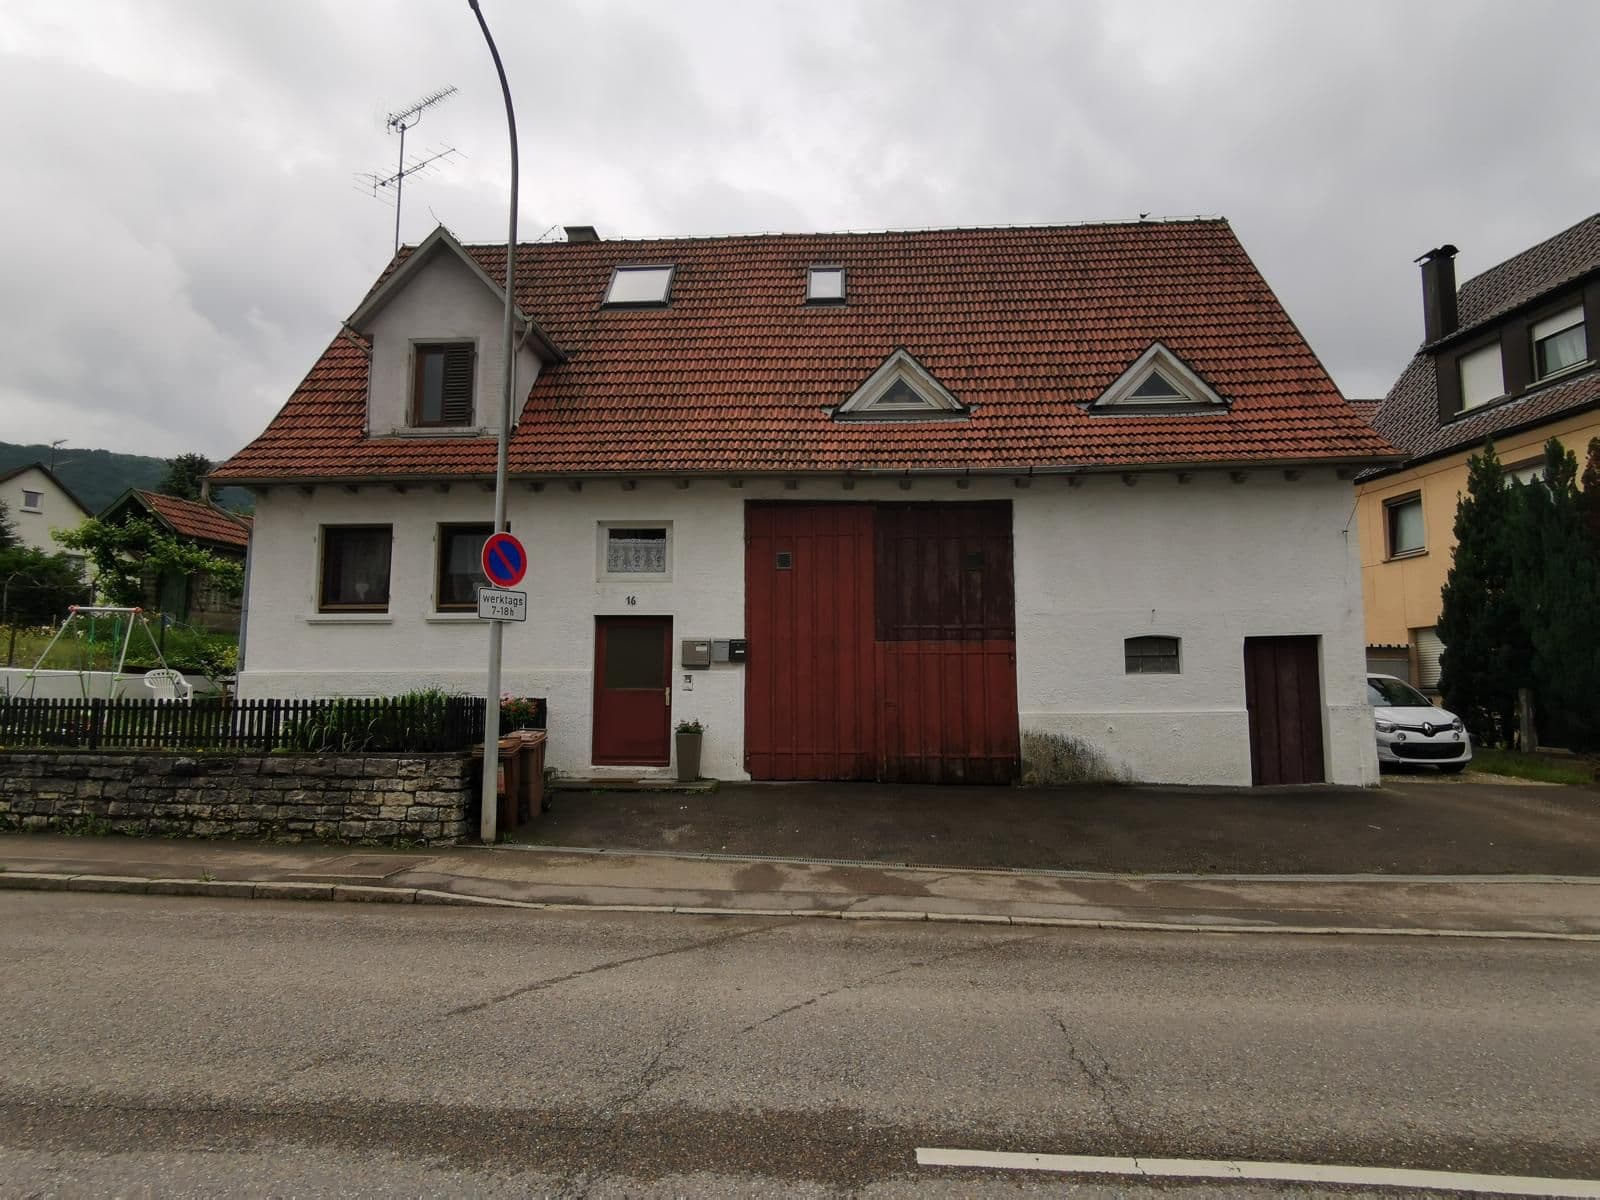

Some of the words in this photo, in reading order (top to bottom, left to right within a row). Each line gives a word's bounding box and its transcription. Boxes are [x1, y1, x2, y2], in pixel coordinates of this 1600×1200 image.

[482, 594, 524, 608] werktags
[626, 596, 637, 606] 16
[491, 605, 515, 616] 7-18h
